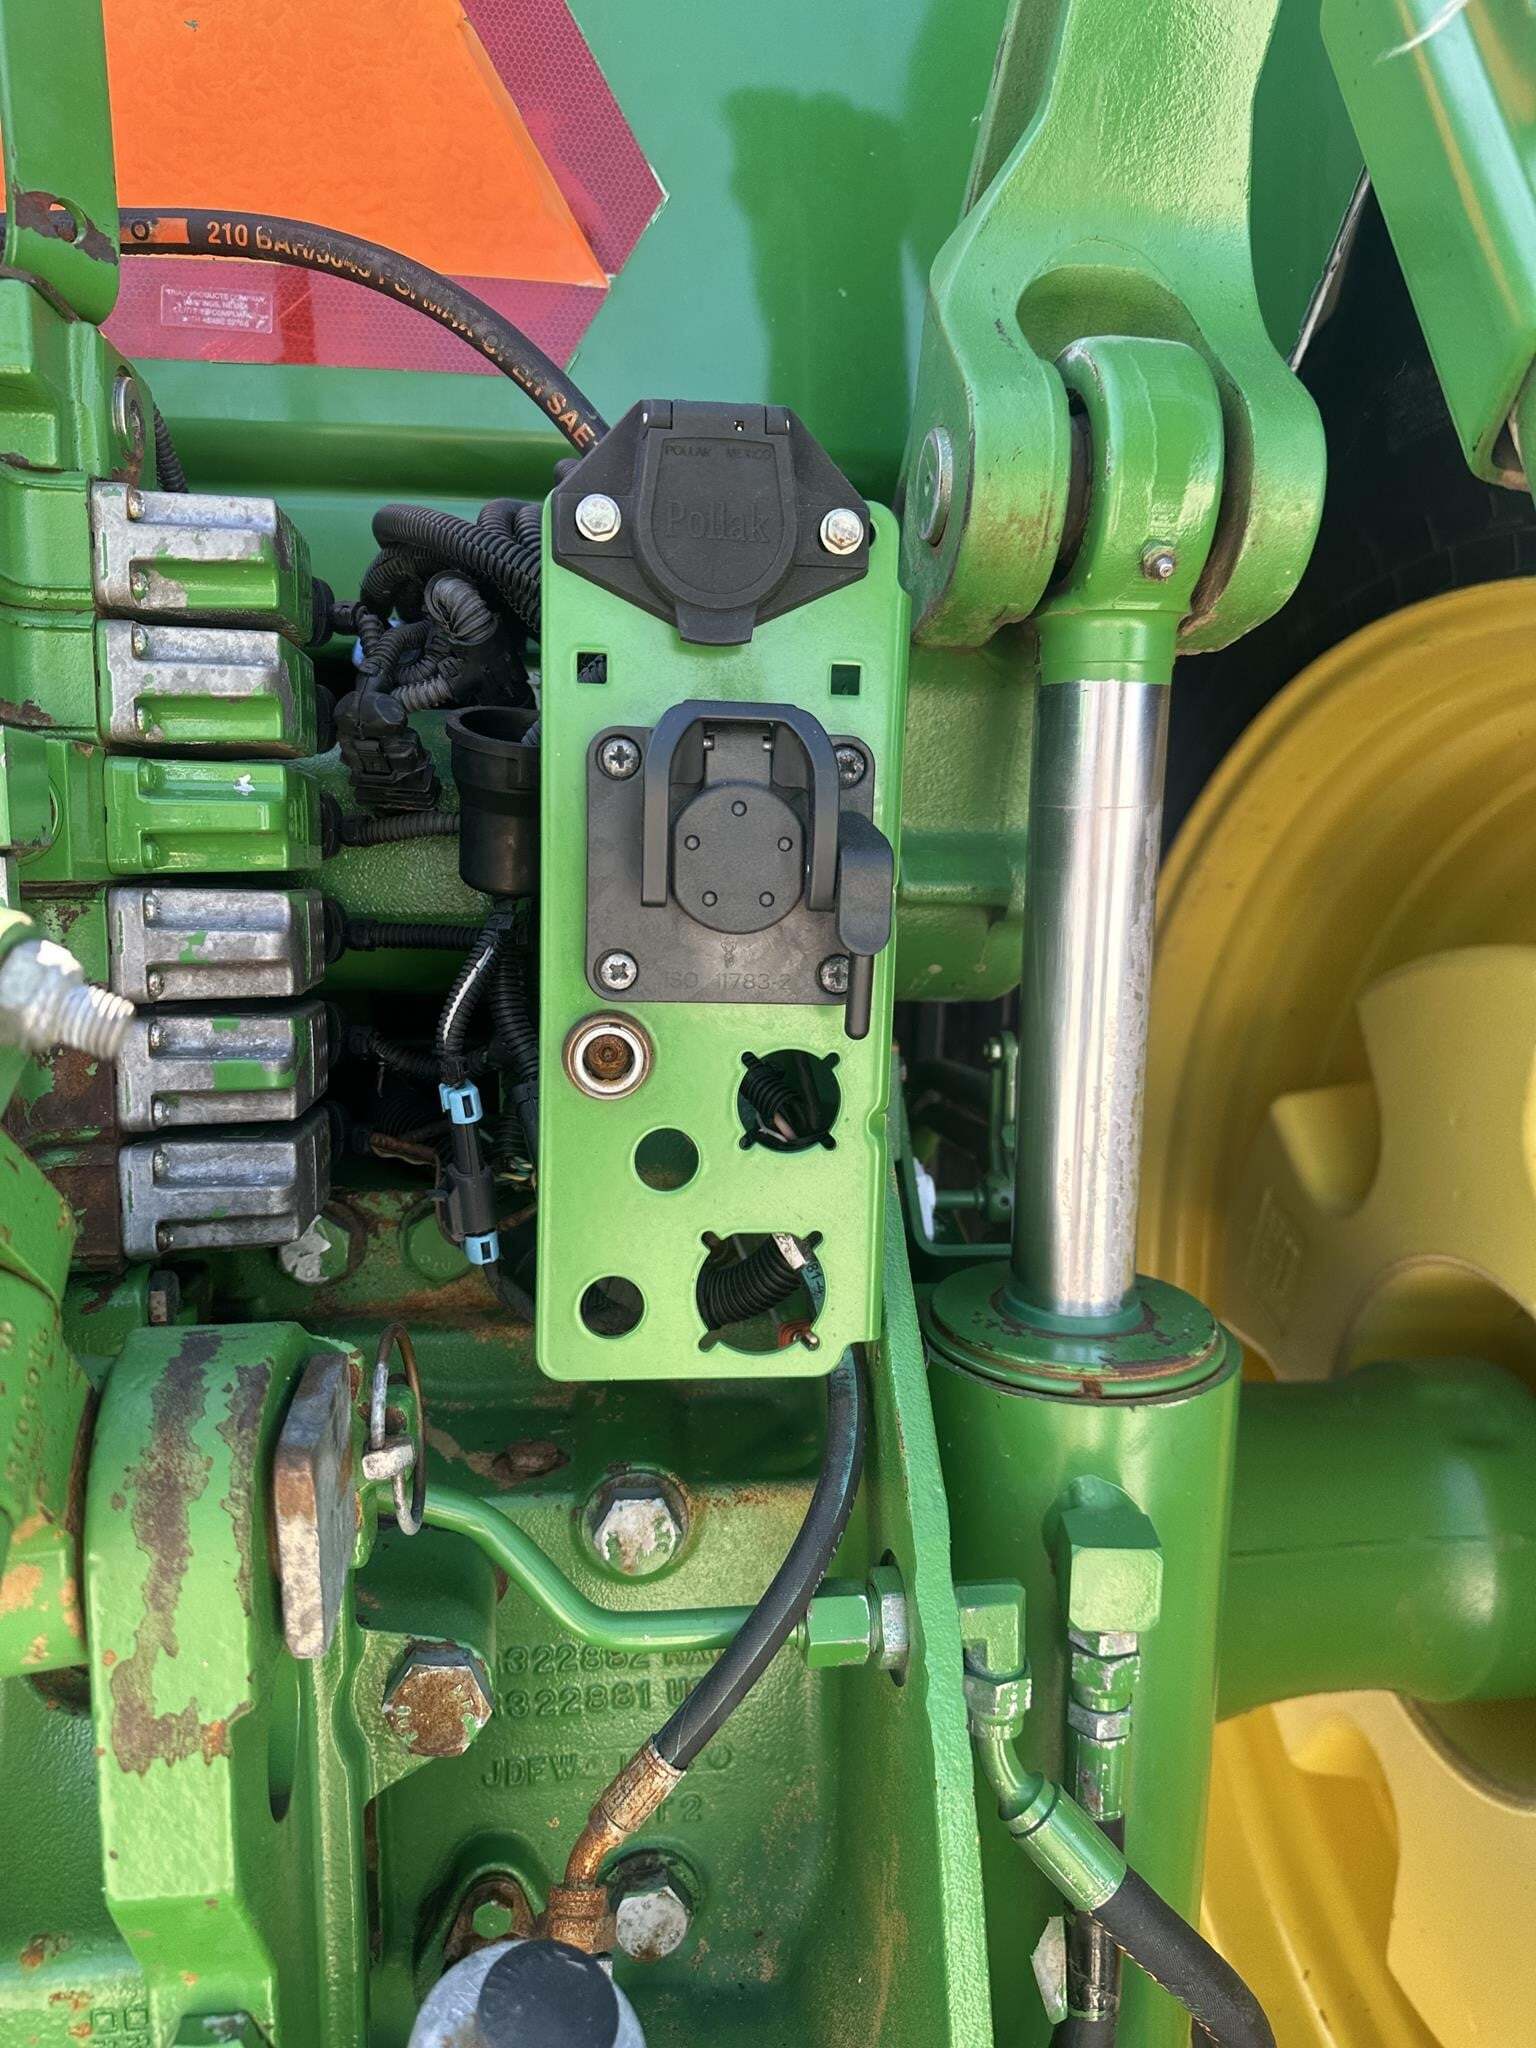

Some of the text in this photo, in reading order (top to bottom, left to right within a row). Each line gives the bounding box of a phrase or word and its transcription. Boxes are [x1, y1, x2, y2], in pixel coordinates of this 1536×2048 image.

[207, 221, 248, 247] 210
[547, 391, 596, 448] SAE
[663, 501, 771, 544] Pollak
[664, 970, 698, 989] ISO
